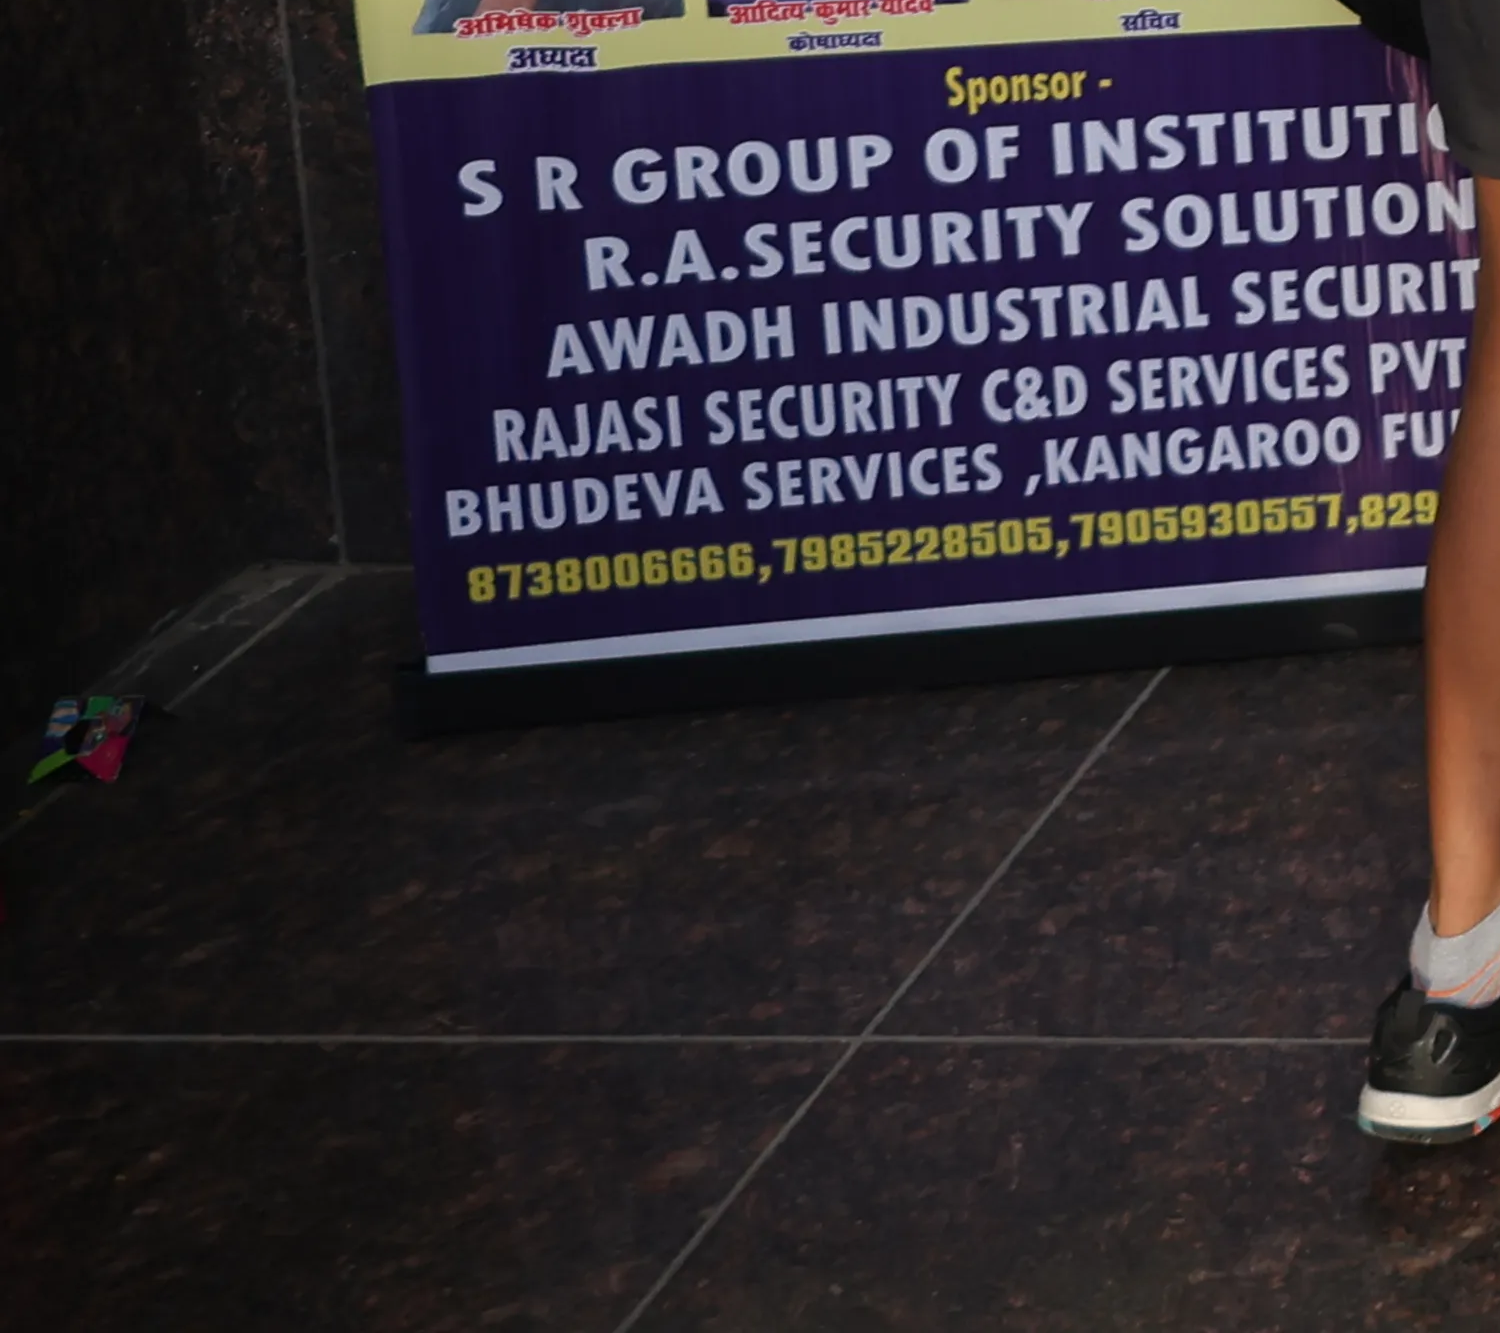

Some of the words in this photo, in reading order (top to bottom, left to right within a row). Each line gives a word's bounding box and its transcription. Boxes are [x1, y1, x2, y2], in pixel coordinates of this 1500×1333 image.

[510, 45, 596, 73] अध्यक्ष
[1119, 8, 1183, 31] सचिव
[946, 68, 1085, 113] Sponsor
[460, 161, 501, 215] S
[537, 157, 581, 209] R
[614, 136, 891, 203] GROUP
[926, 126, 1018, 182] OF
[549, 311, 794, 379] AWADH
[824, 281, 1213, 363] INDUSTRIAL
[495, 397, 681, 461] RAJASI
[706, 374, 960, 444] SECURITY
[983, 366, 1086, 421] C&D
[1108, 345, 1348, 413] SERVICES
[447, 469, 722, 536] BHUDEVA
[743, 433, 1001, 509] SERVICES
